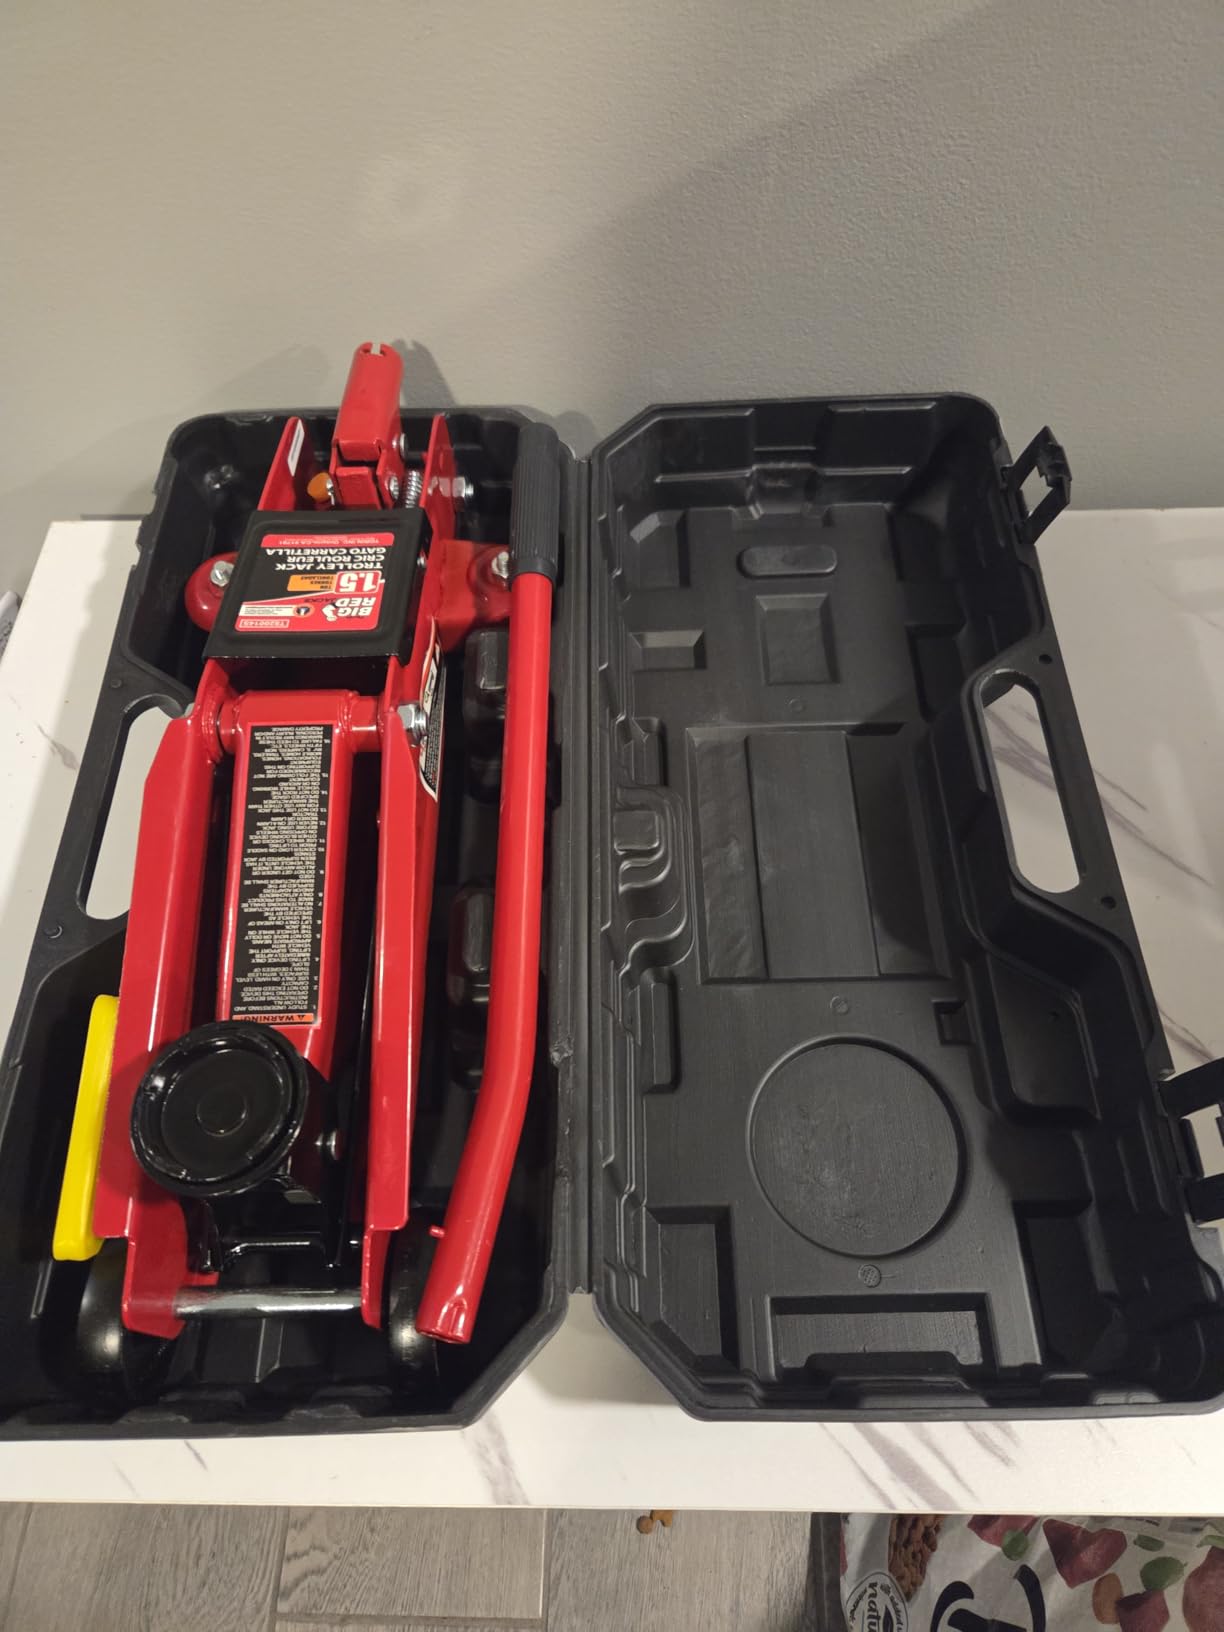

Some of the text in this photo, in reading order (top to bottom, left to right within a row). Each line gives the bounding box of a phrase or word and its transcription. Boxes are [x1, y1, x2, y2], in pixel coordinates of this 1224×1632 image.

[339, 572, 377, 592] 1.5
[335, 597, 376, 606] RED
[337, 606, 373, 617] BIG
